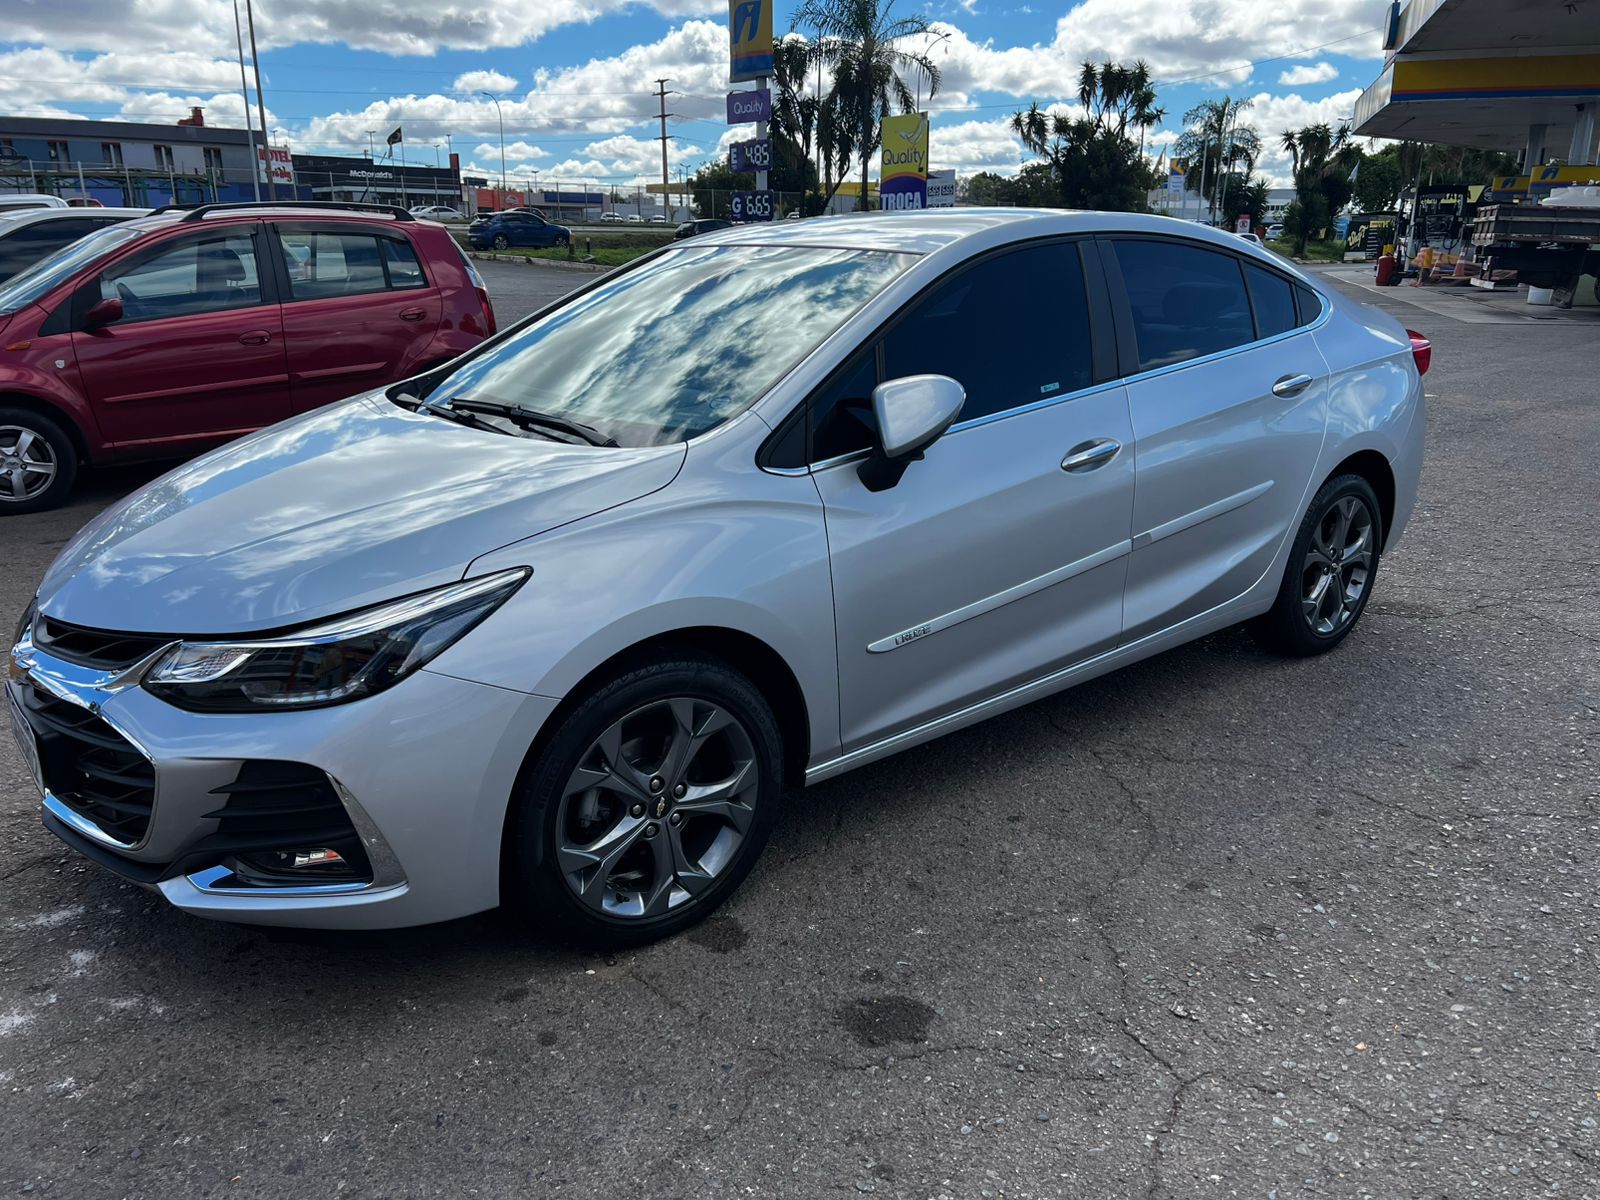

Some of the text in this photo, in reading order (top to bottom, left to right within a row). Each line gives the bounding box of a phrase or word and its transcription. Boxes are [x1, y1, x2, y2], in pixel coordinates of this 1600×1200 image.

[733, 102, 763, 115] Quality
[882, 148, 925, 167] Quality
[350, 170, 392, 178] McDonald's
[732, 197, 741, 213] G
[881, 192, 922, 209] TROCA
